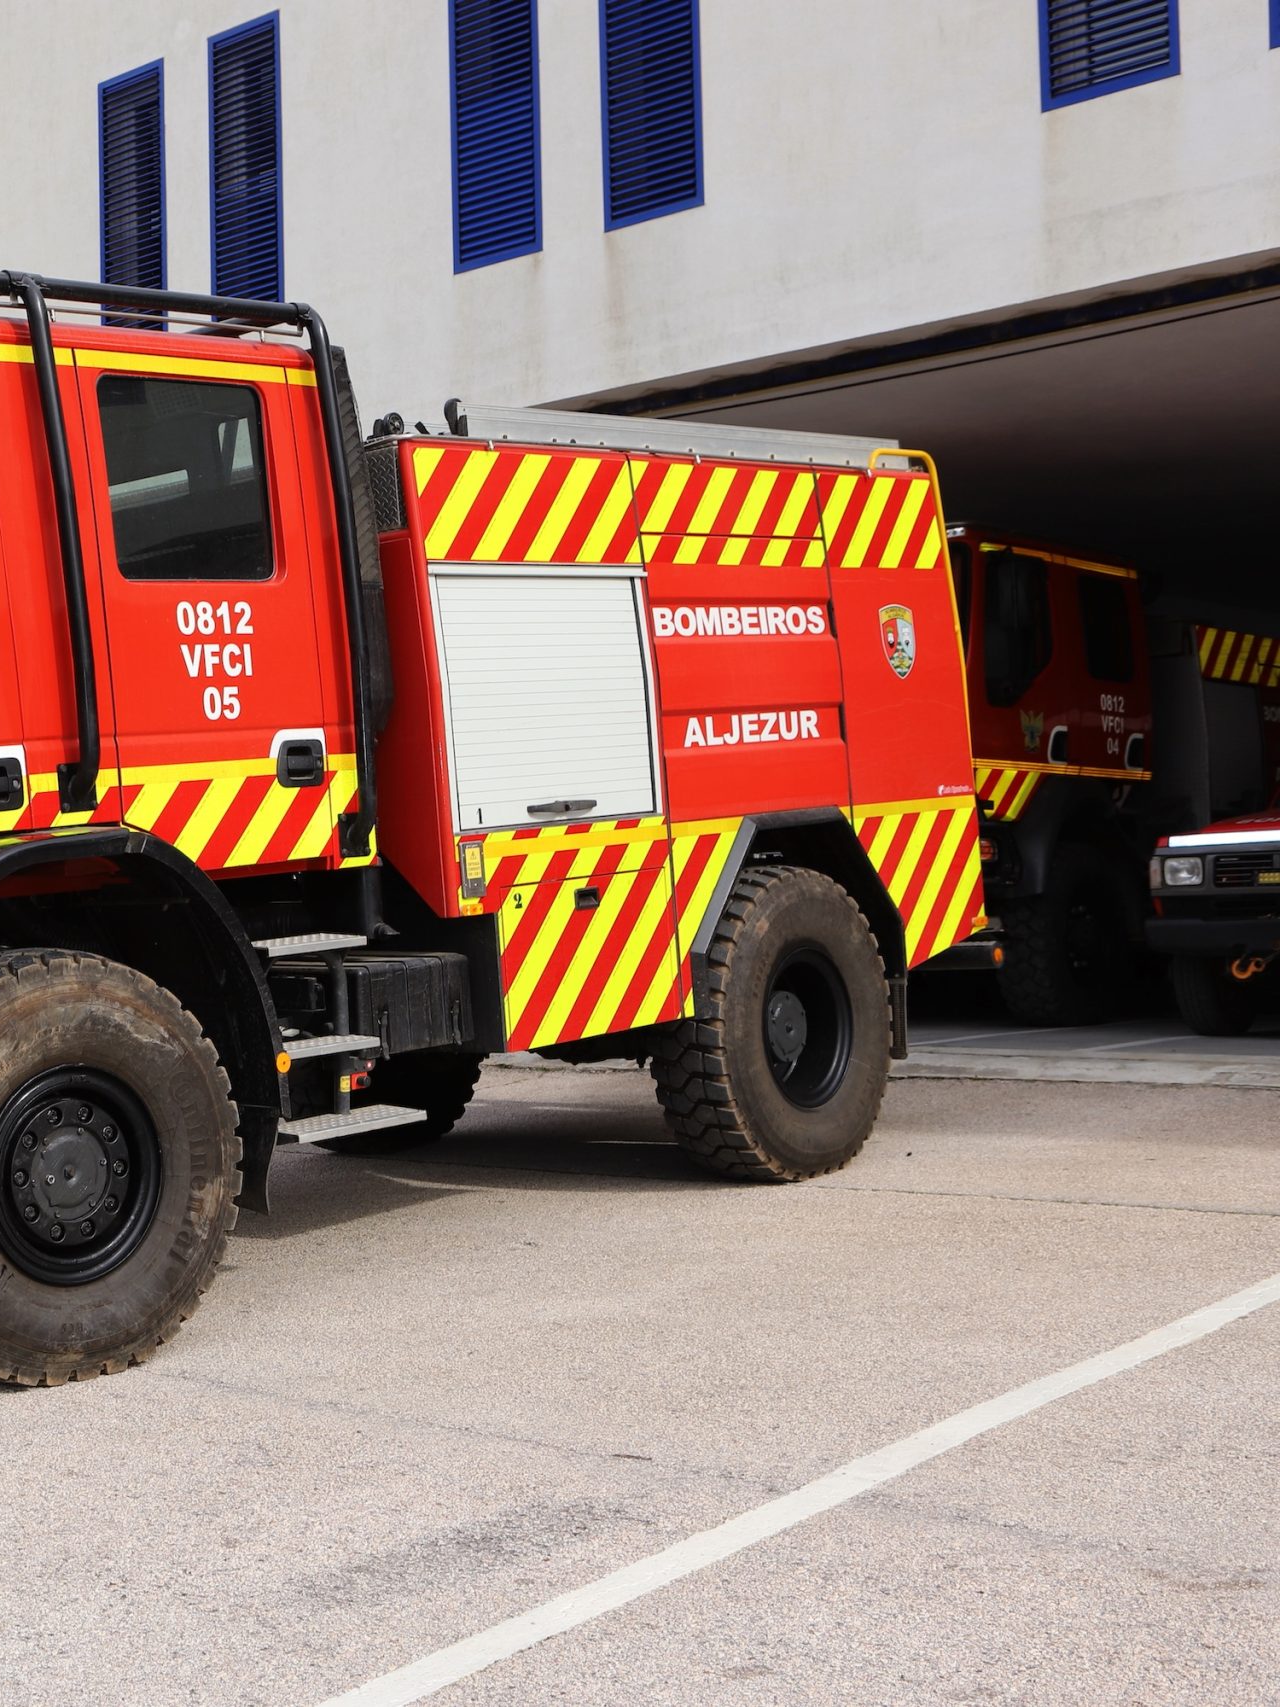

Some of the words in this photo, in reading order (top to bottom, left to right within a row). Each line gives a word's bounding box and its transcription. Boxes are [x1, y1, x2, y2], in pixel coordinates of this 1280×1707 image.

[176, 601, 254, 635] 0812
[652, 606, 826, 637] BOMBEIROS
[180, 643, 253, 678] VFCI
[203, 686, 241, 721] 05
[1100, 693, 1125, 713] 0812
[683, 710, 820, 748] ALJEZUR
[1101, 714, 1125, 734] VFCI
[1107, 737, 1119, 755] 04
[476, 808, 483, 825] 1
[513, 893, 523, 909] 2
